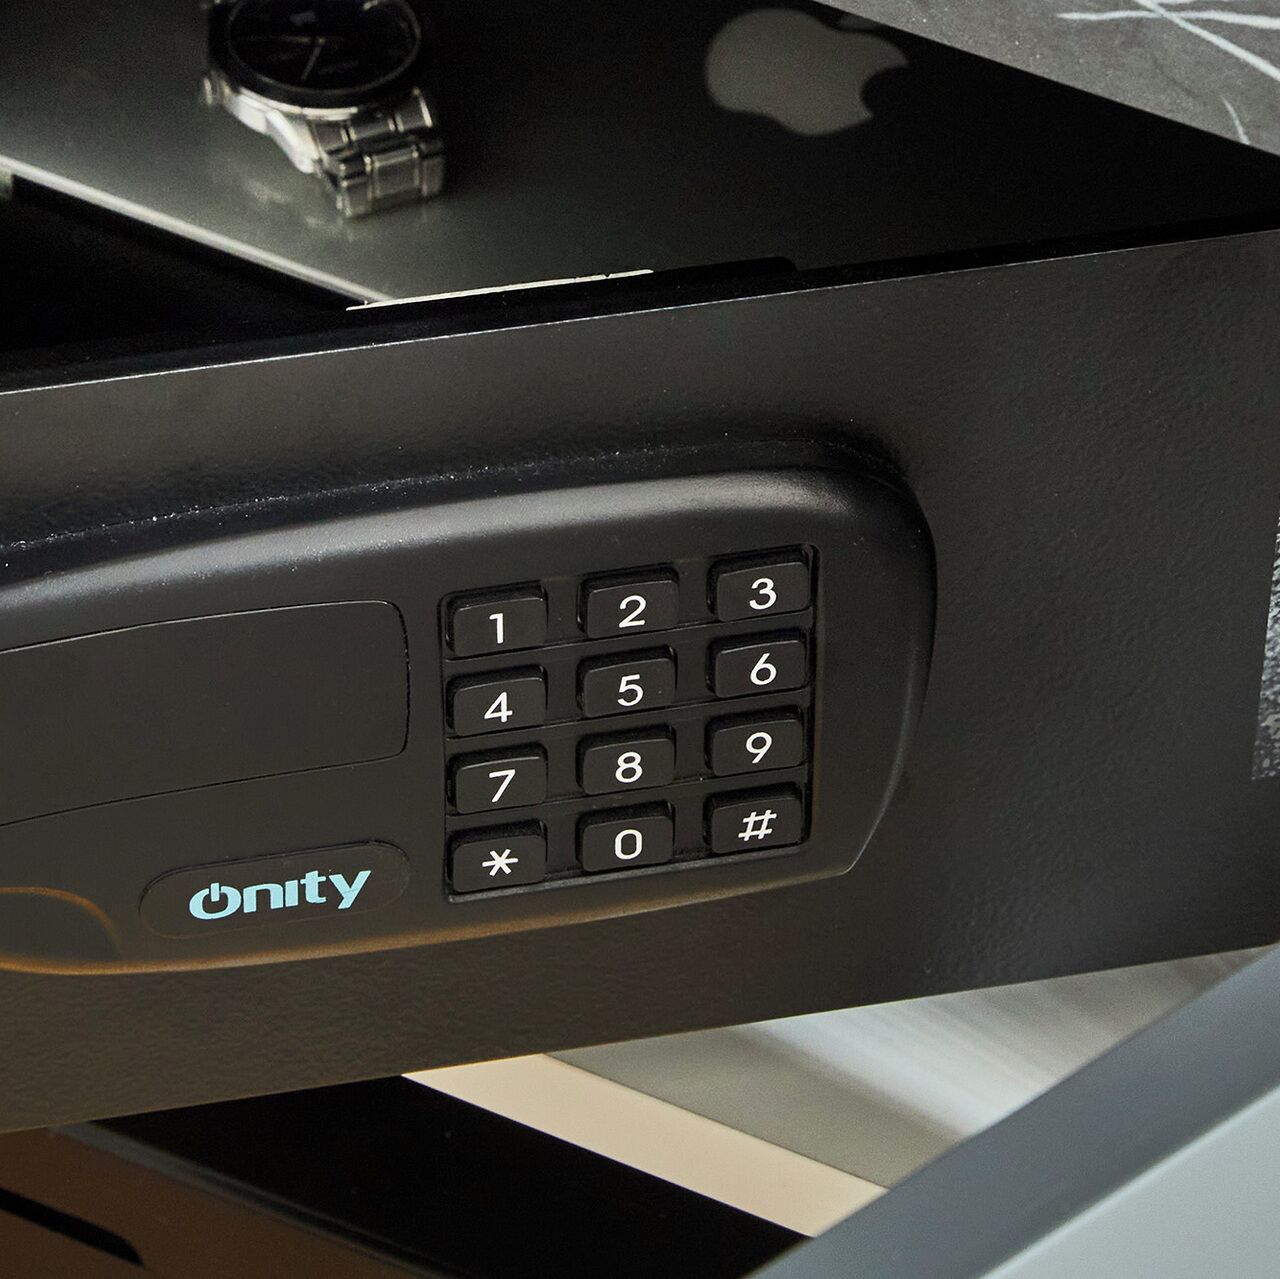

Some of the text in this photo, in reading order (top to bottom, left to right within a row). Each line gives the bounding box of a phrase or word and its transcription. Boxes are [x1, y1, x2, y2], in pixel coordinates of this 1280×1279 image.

[618, 594, 648, 629] 2
[748, 577, 779, 611] 3
[489, 612, 505, 645] 1
[750, 651, 778, 687] 6
[483, 691, 514, 723] 4
[617, 673, 645, 708] 5
[745, 730, 774, 765] 9
[614, 750, 644, 785] 8
[487, 768, 516, 803] 7
[737, 808, 778, 842] #
[613, 828, 644, 861] 0
[188, 869, 372, 921] Onity
